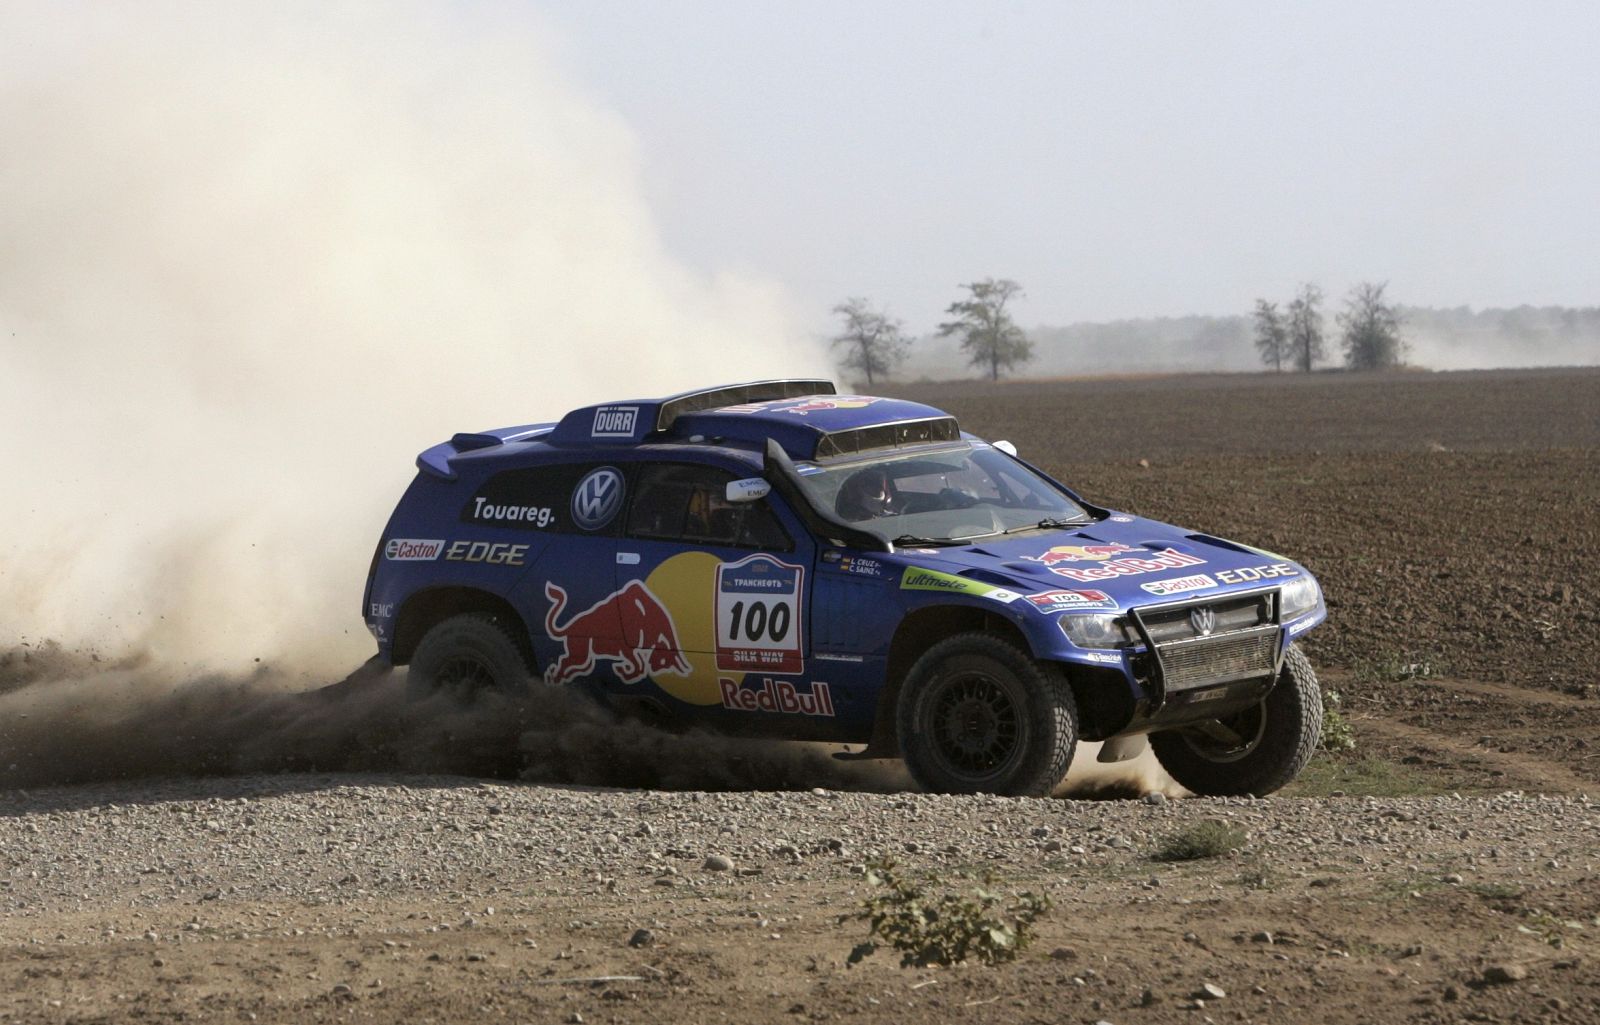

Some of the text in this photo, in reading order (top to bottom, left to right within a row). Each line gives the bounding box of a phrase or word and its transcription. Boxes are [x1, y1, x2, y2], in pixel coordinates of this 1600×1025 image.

[399, 541, 530, 566] Castrol EDGE
[906, 574, 968, 590] ultimate
[1159, 563, 1299, 592] Castrol EDGE
[729, 601, 791, 642] 100
[733, 651, 785, 663] SILK WAY
